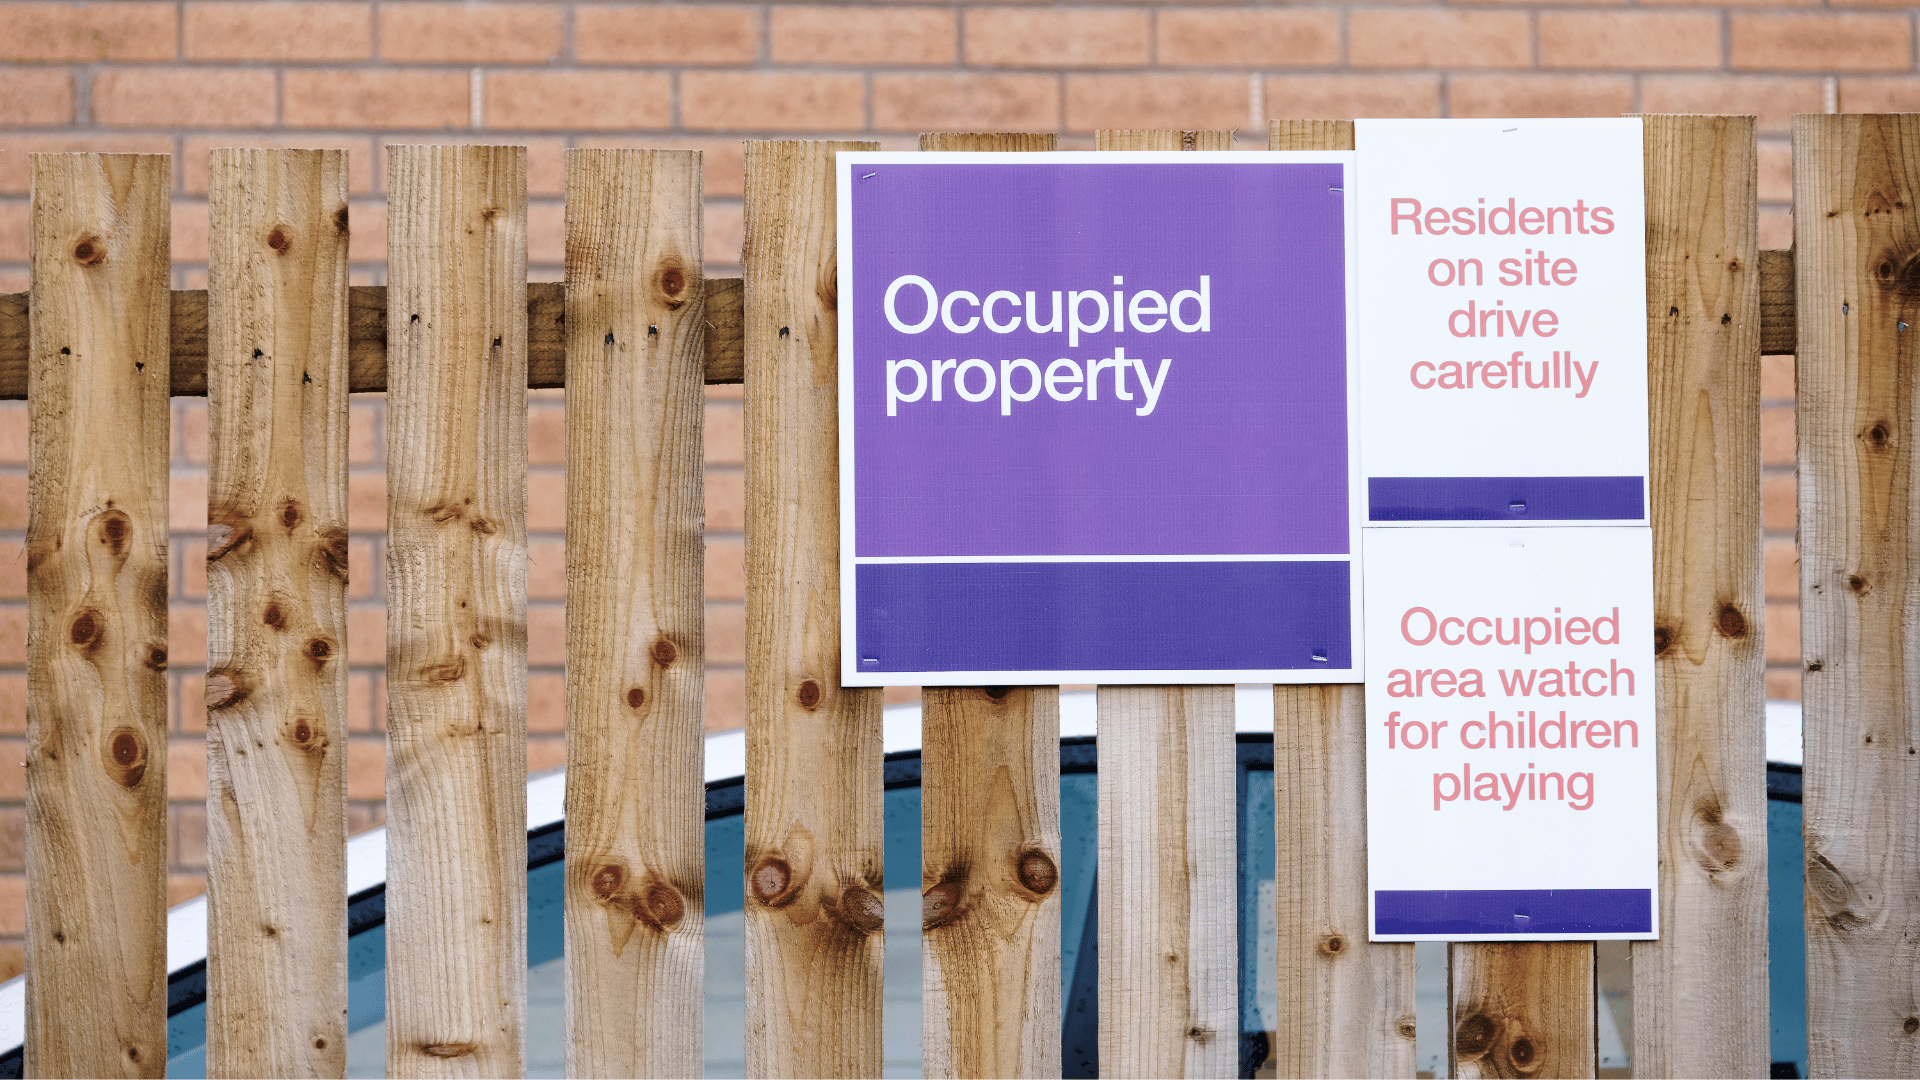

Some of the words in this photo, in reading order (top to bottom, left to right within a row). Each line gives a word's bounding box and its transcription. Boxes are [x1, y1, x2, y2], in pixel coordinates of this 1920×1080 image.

[1390, 198, 1615, 236] Residents
[1428, 257, 1483, 286] on
[1498, 249, 1578, 286] site
[883, 274, 1211, 347] Occupied
[1448, 300, 1559, 338] drive
[886, 347, 1172, 416] property
[1410, 351, 1599, 399] carefully
[1400, 606, 1620, 654] Occupied
[1386, 667, 1486, 698] area
[1498, 659, 1635, 698] watch
[1384, 711, 1448, 750] for
[1460, 711, 1639, 749] children
[1433, 763, 1594, 811] playing
